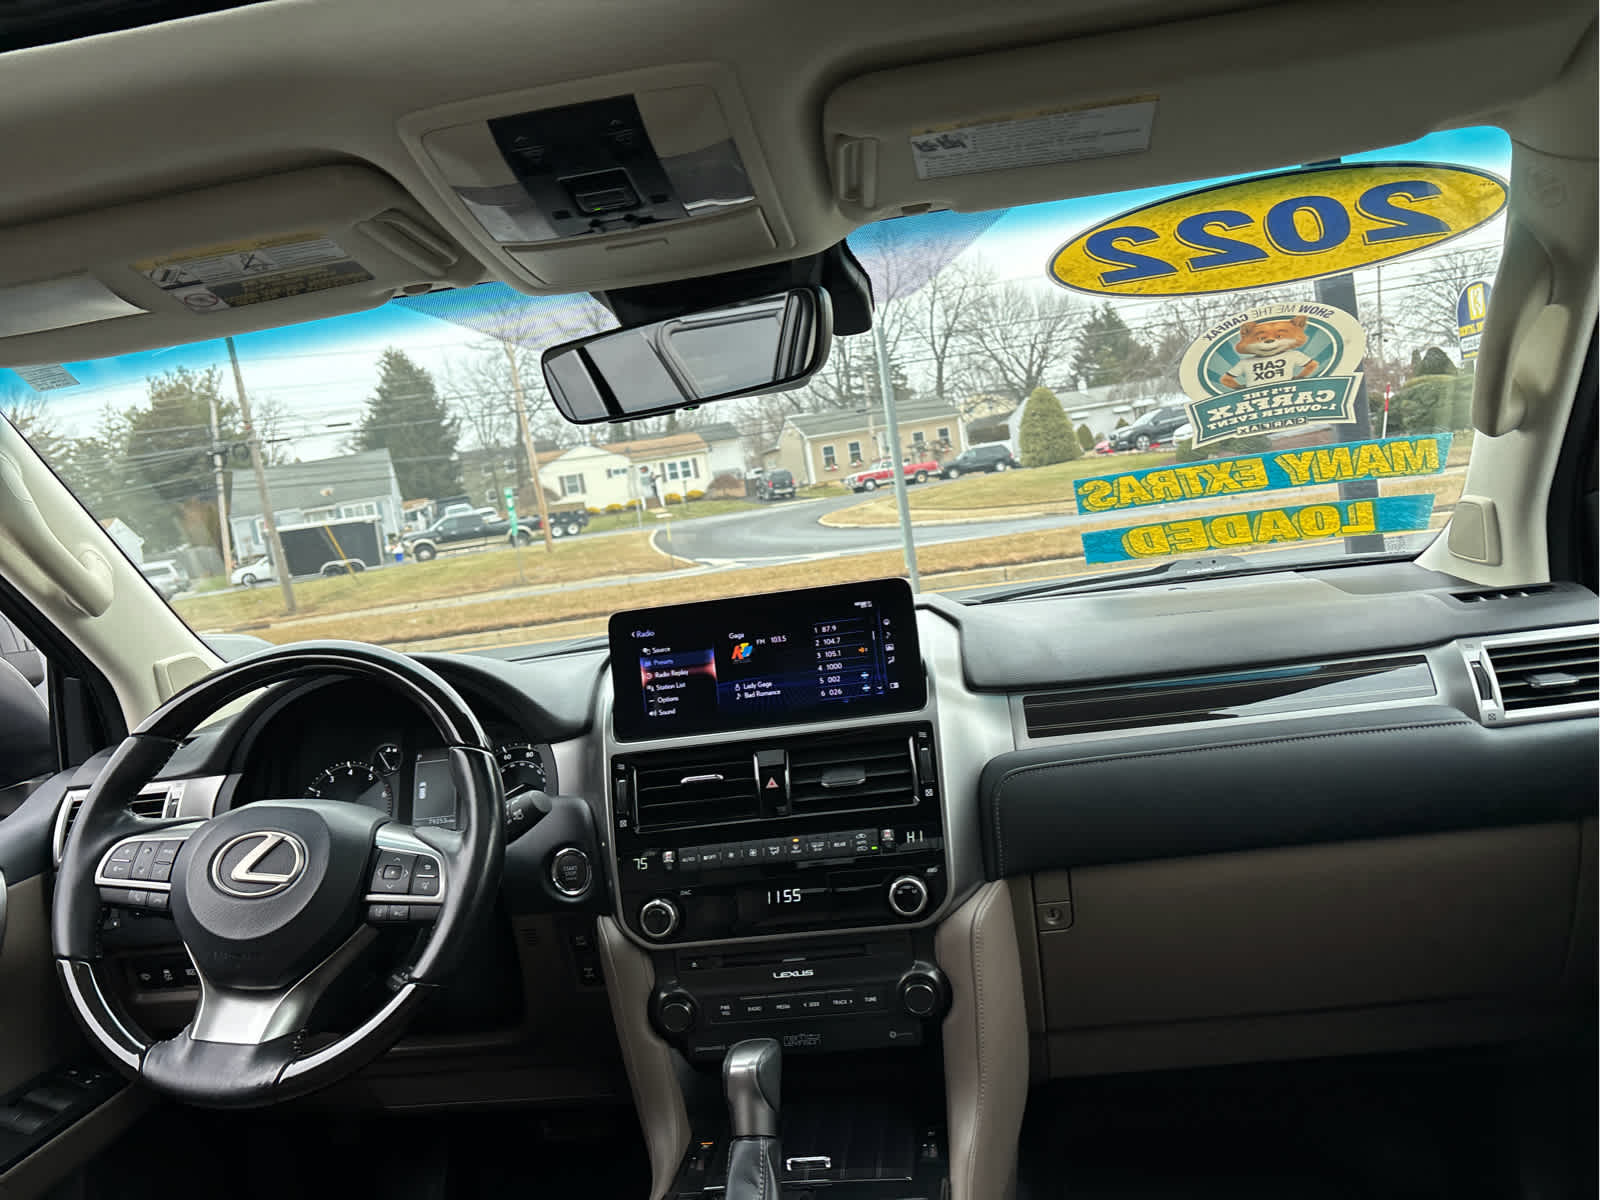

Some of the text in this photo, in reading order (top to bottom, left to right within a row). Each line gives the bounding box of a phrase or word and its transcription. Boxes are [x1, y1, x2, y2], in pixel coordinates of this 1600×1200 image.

[636, 630, 655, 638] Radio
[632, 857, 648, 870] 75
[772, 969, 814, 979] LEXUS
